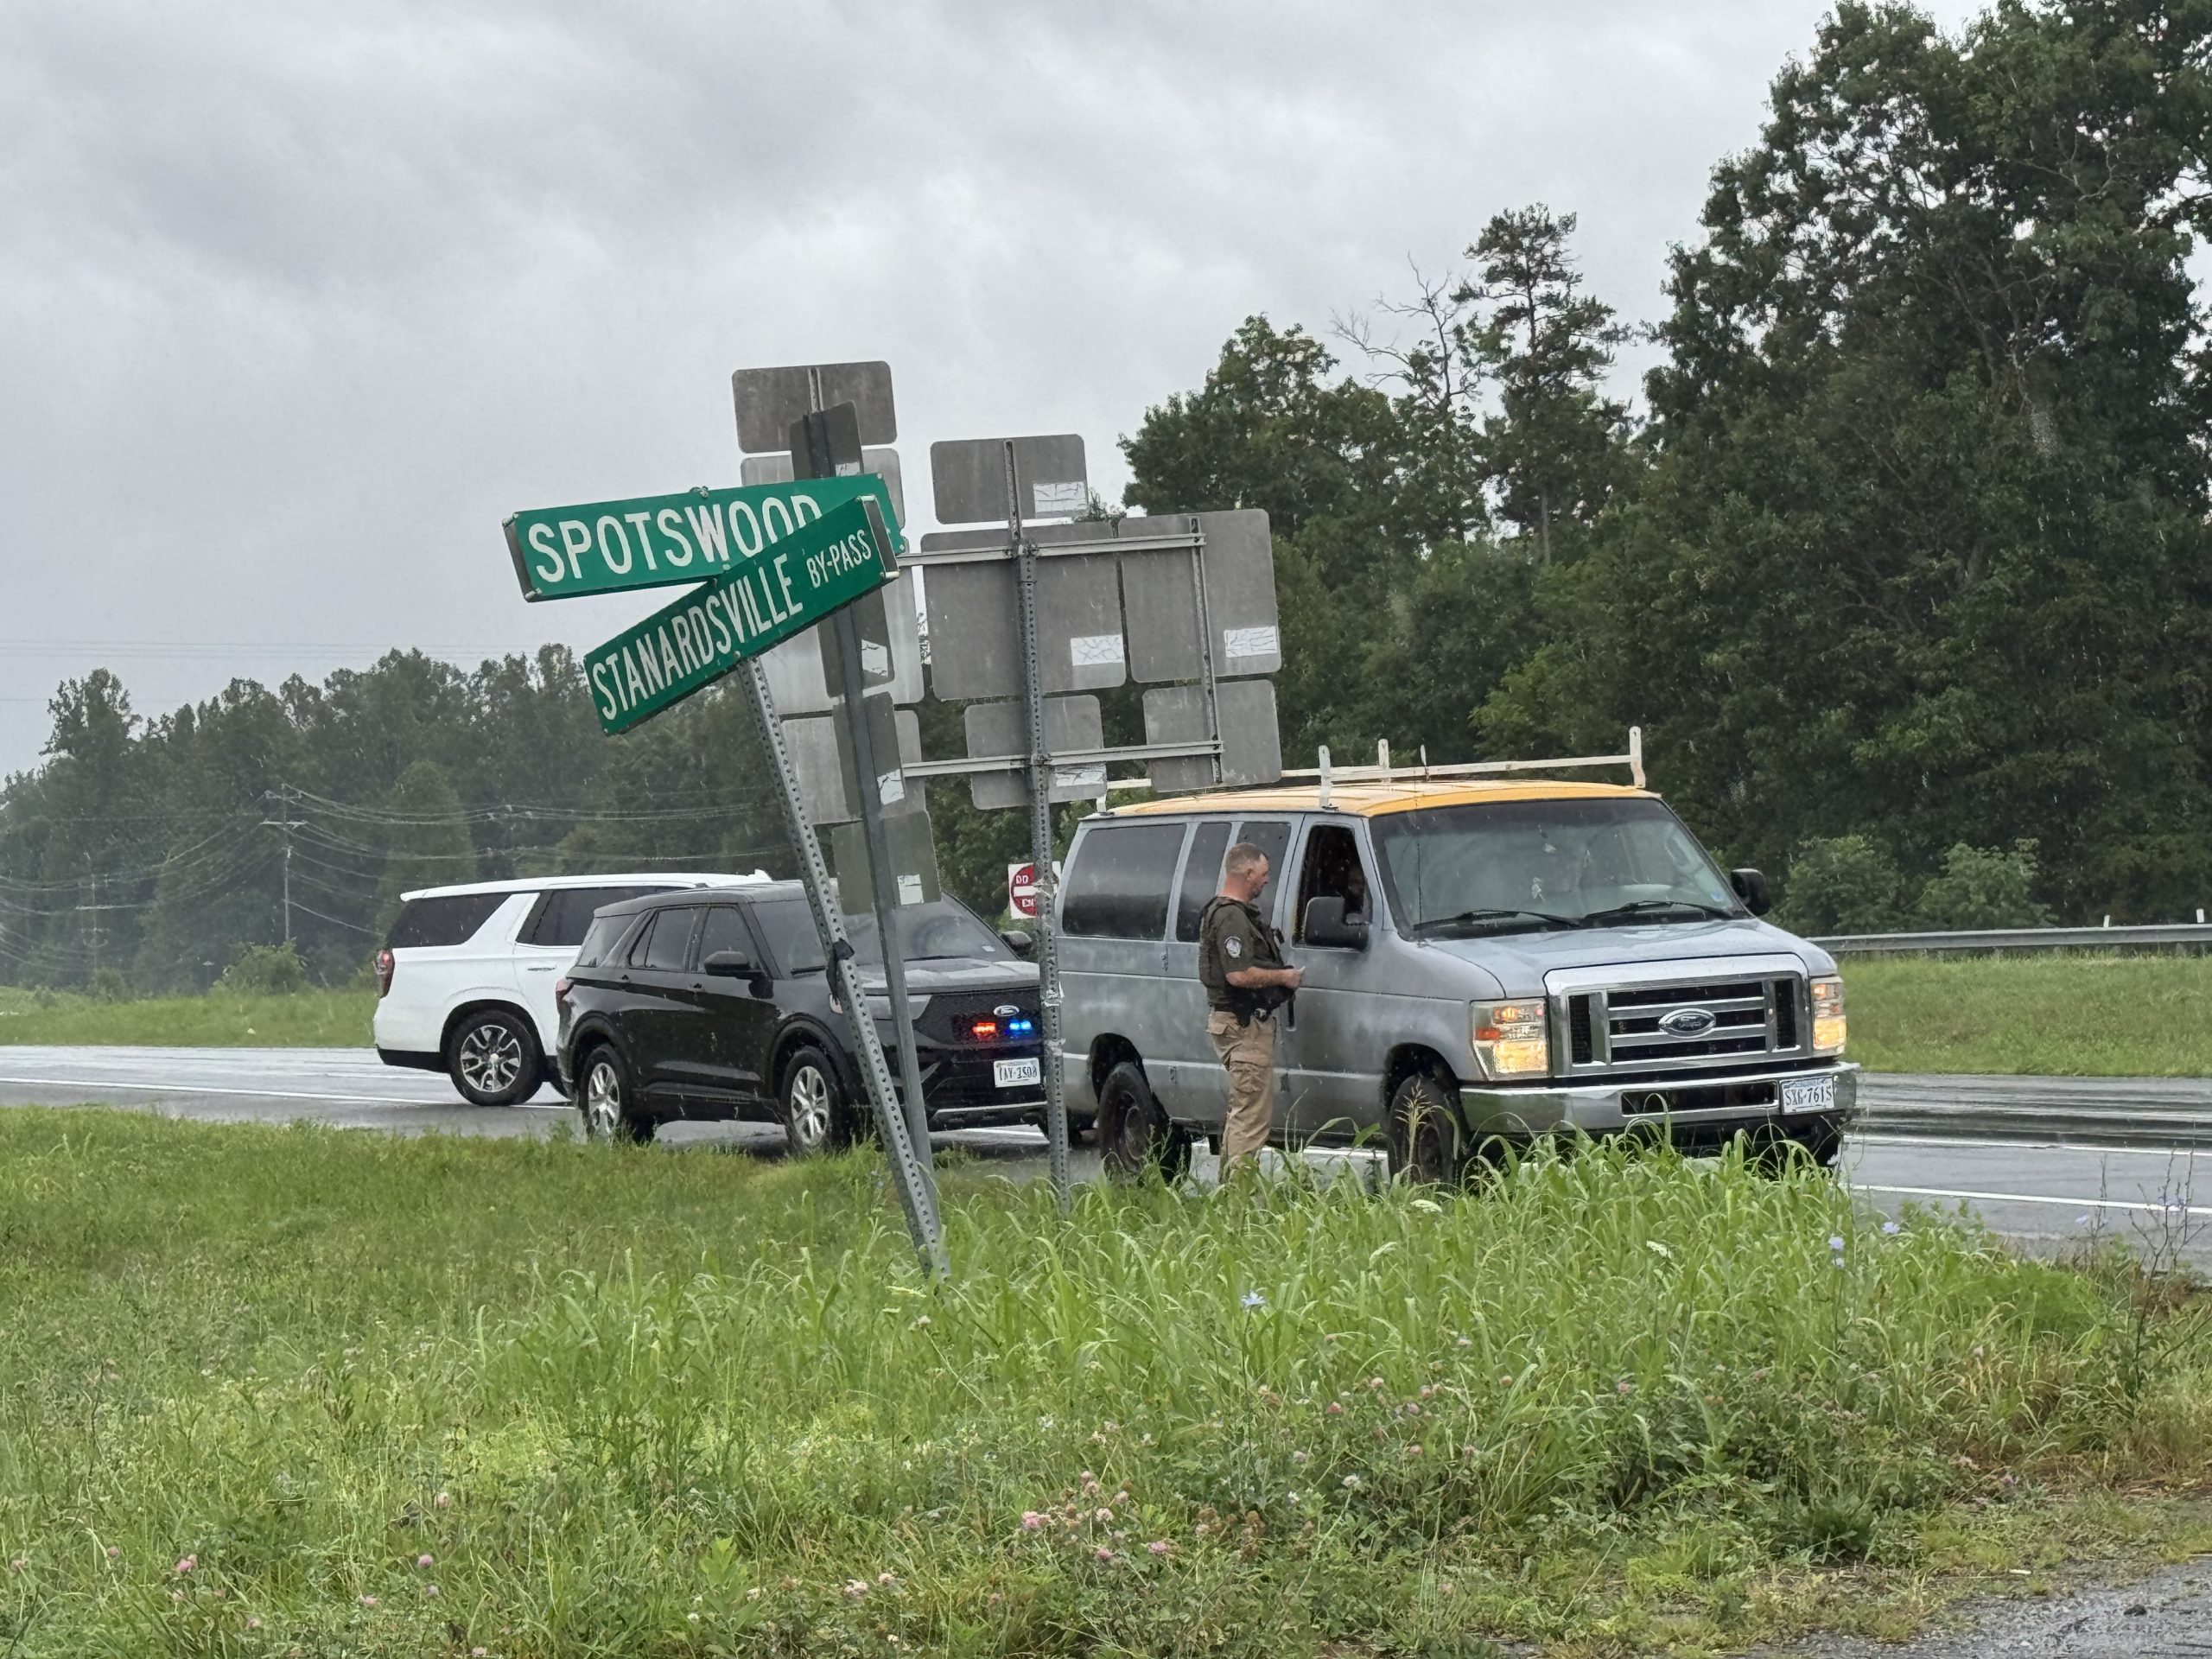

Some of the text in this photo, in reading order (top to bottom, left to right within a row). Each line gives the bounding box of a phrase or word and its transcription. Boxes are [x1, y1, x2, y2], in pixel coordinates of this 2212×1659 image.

[528, 494, 823, 583] SPOTSWOOD
[592, 528, 872, 721] STANARDSVILLE BY-PASS
